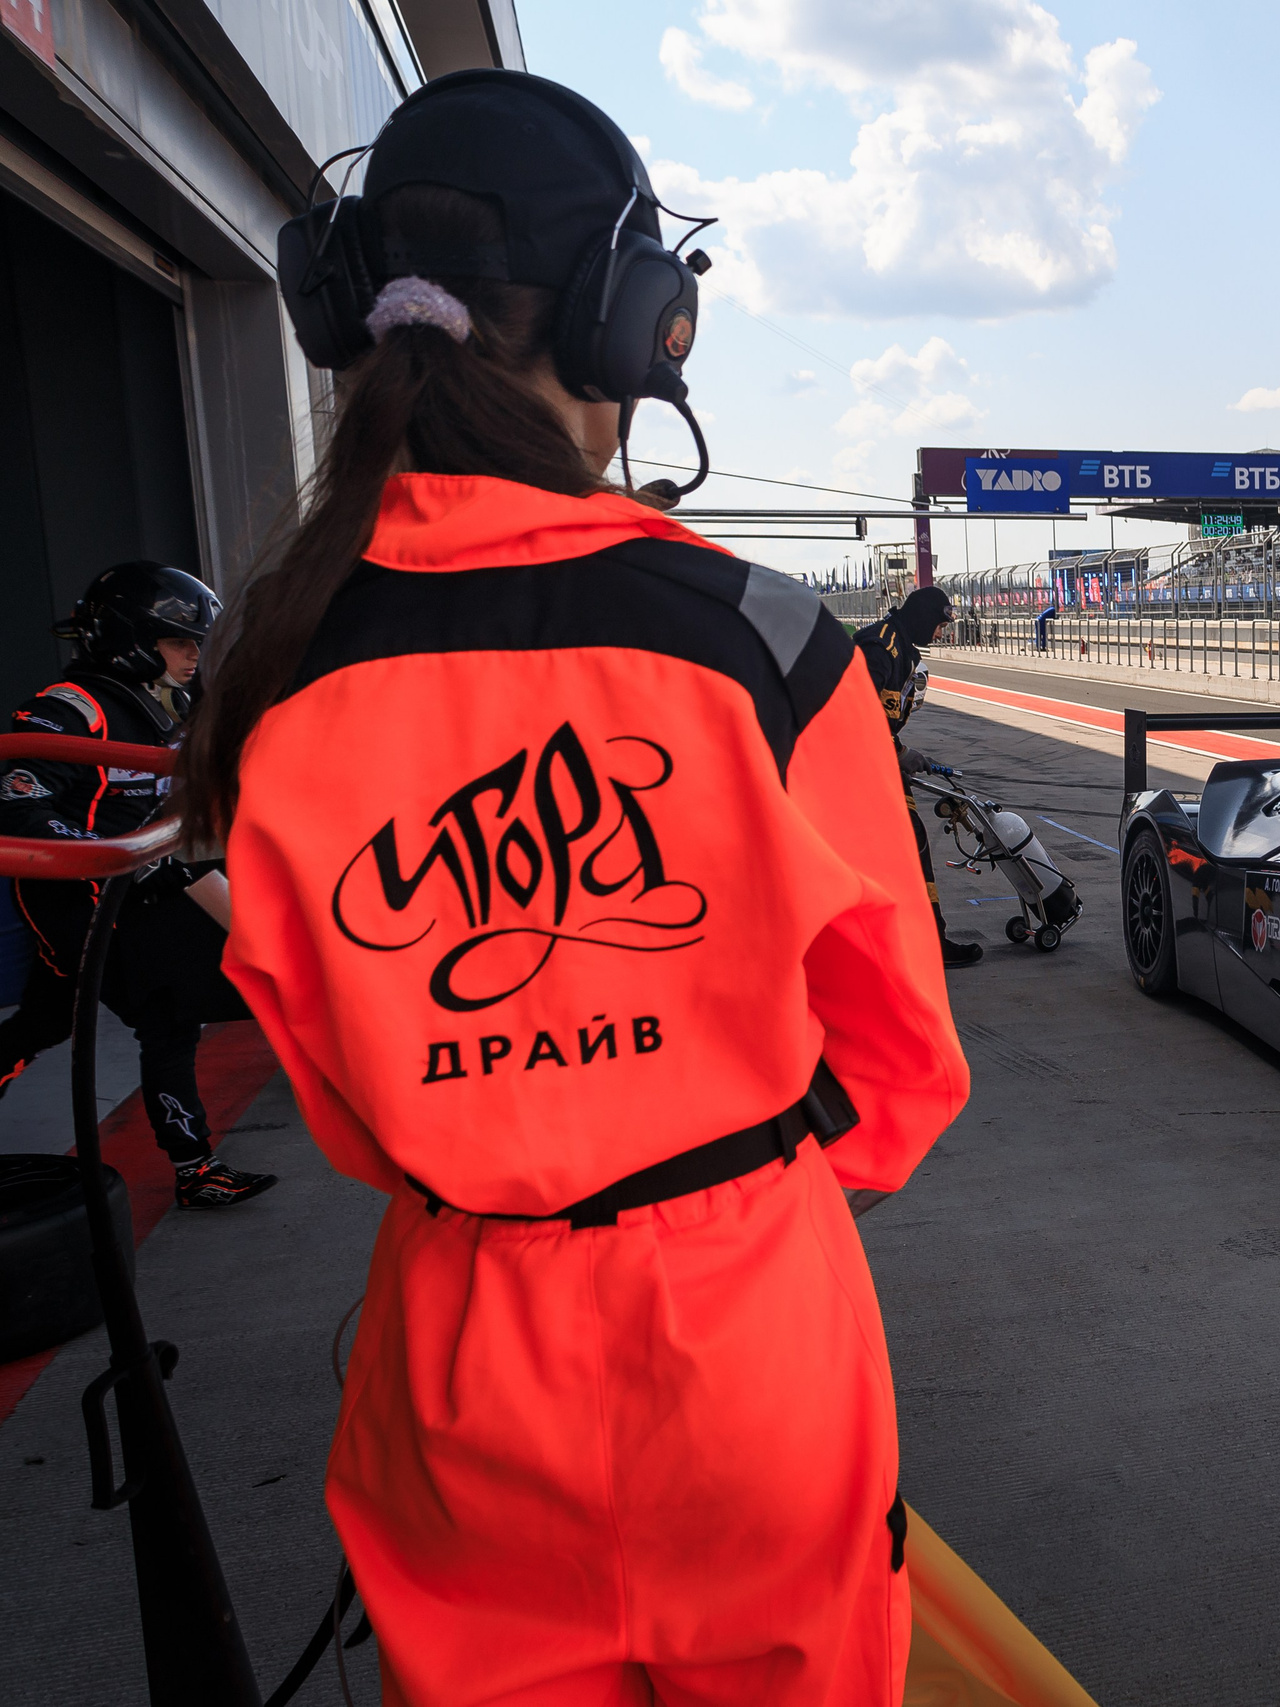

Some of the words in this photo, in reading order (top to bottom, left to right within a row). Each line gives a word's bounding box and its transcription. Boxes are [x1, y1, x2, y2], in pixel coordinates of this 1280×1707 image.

[975, 468, 1062, 492] YADRO
[1103, 465, 1152, 489] ВТБ
[1234, 467, 1280, 490] ВТБ
[1203, 526, 1242, 536] 00:20:10
[1204, 515, 1242, 525] 11:24:49
[1264, 878, 1271, 890] А.
[421, 1014, 664, 1085] ДРАЙВ
